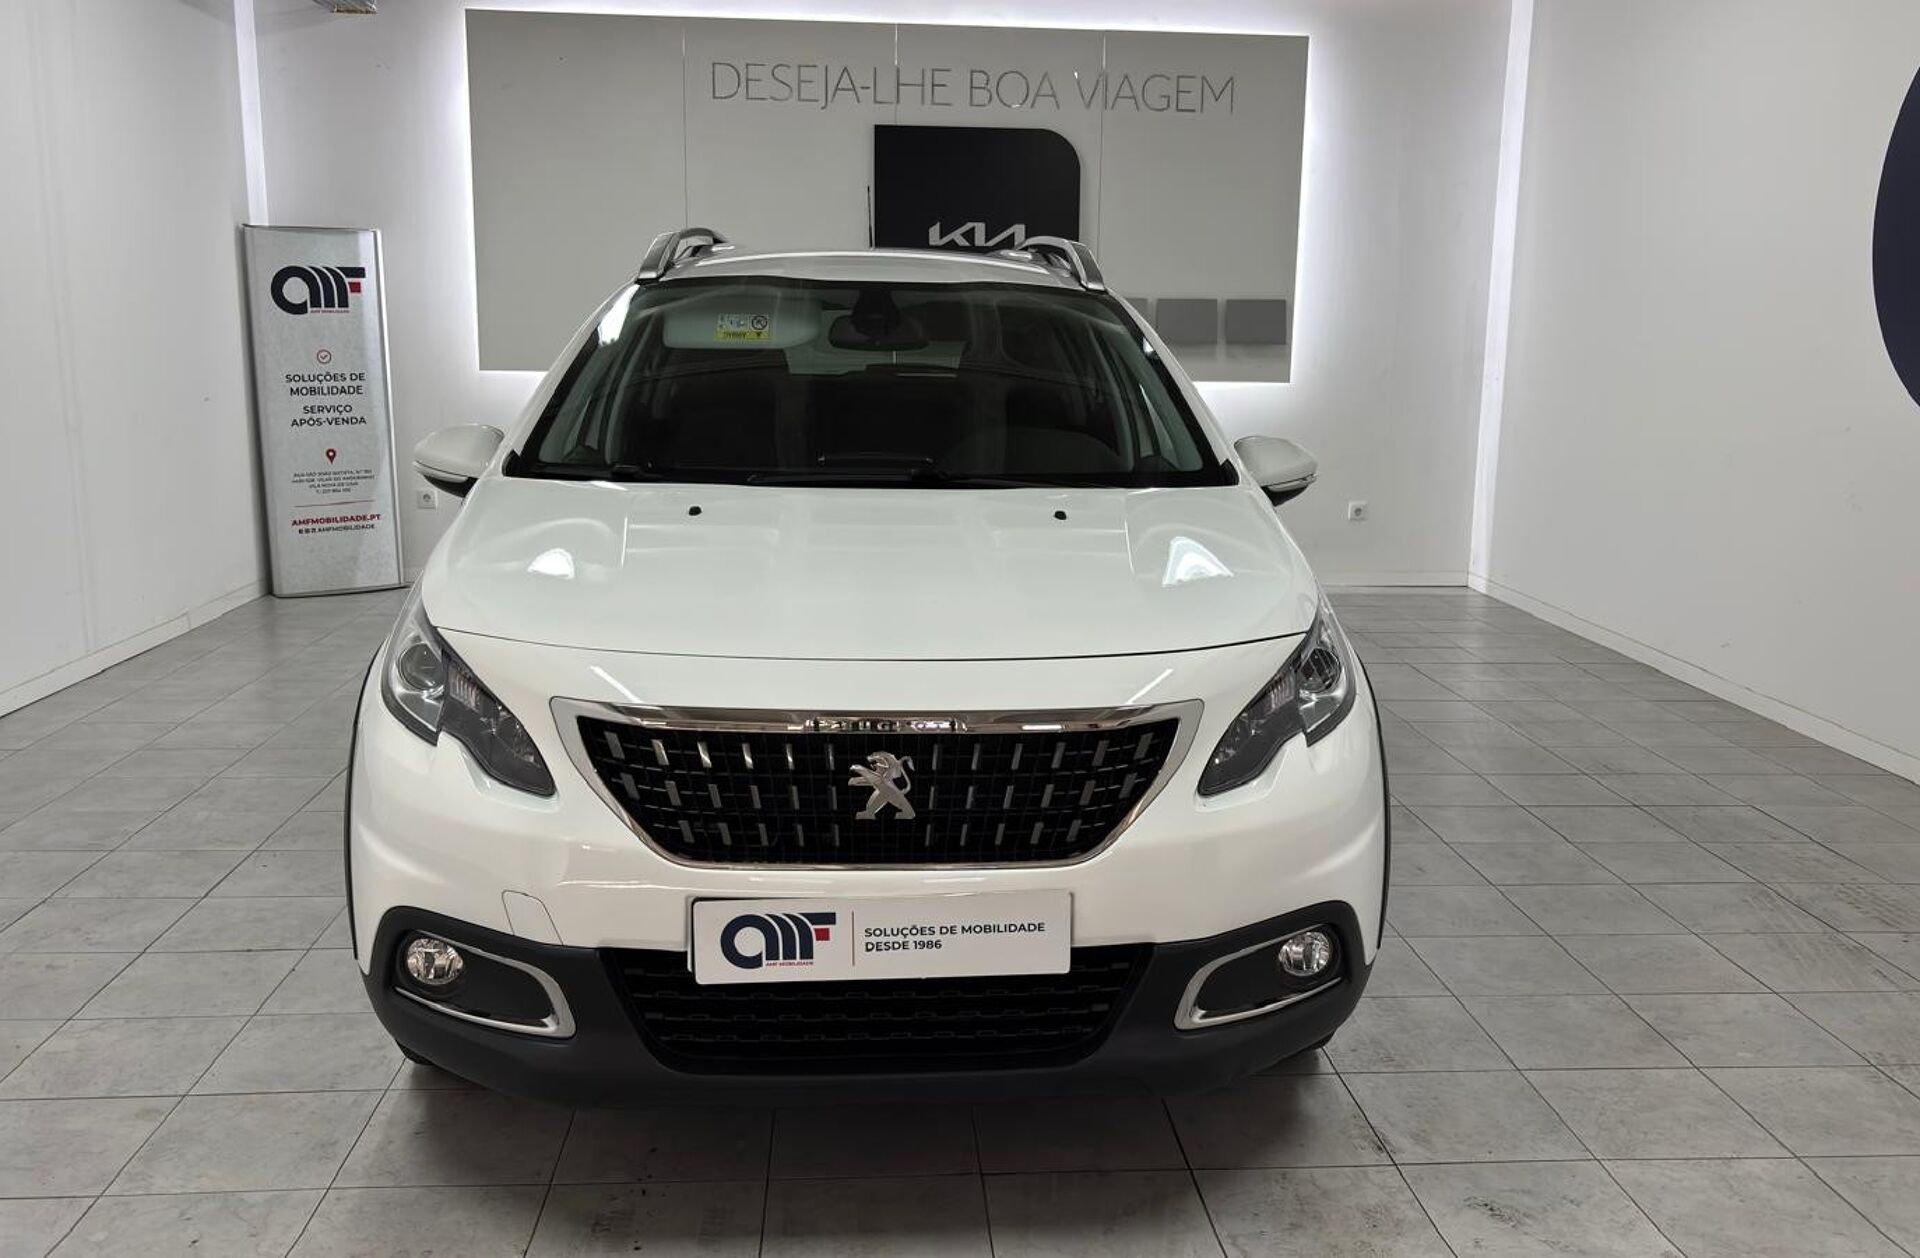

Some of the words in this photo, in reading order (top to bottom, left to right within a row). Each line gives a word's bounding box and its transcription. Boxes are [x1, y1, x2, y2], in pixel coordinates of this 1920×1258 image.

[712, 62, 953, 110] DESEJA-LHE
[969, 69, 1061, 110] BOA
[1074, 72, 1235, 114] VIAGEM
[285, 371, 347, 384] SOLUÇÕES
[350, 372, 366, 382] DE
[290, 385, 364, 396] MOBILIDADE
[303, 404, 353, 415] SERVIÇO
[291, 416, 367, 428] APÓS-VENDA
[292, 514, 380, 526] AMFMOBILIDADE.PT
[864, 925, 936, 938] SOLUÇÕES
[939, 925, 958, 936] DE
[961, 922, 1046, 935] MOBILIDADE
[865, 941, 910, 952] DESDE
[913, 939, 943, 950] 1986
